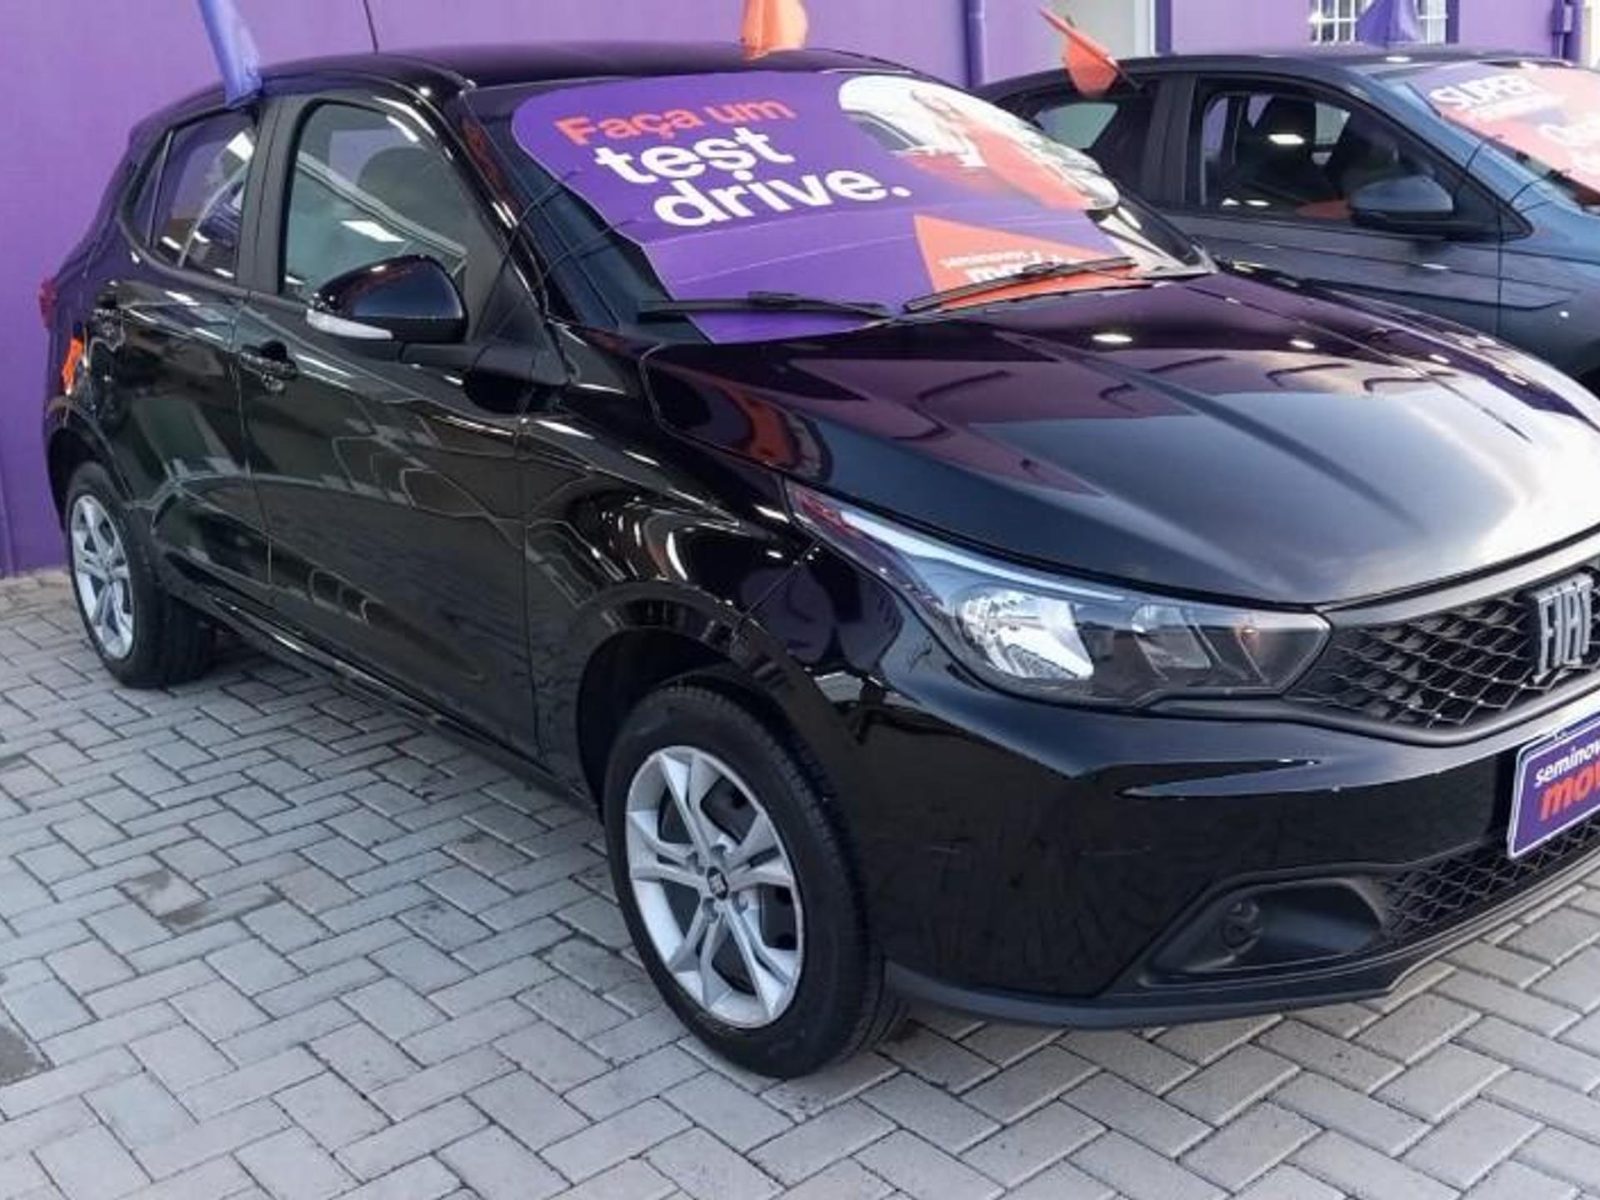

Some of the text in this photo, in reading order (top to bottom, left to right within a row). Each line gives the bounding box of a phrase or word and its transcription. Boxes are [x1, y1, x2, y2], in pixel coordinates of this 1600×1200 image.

[555, 99, 797, 145] Faça um
[593, 127, 796, 184] test
[653, 170, 912, 227] drive.
[1534, 576, 1594, 682] FIAT
